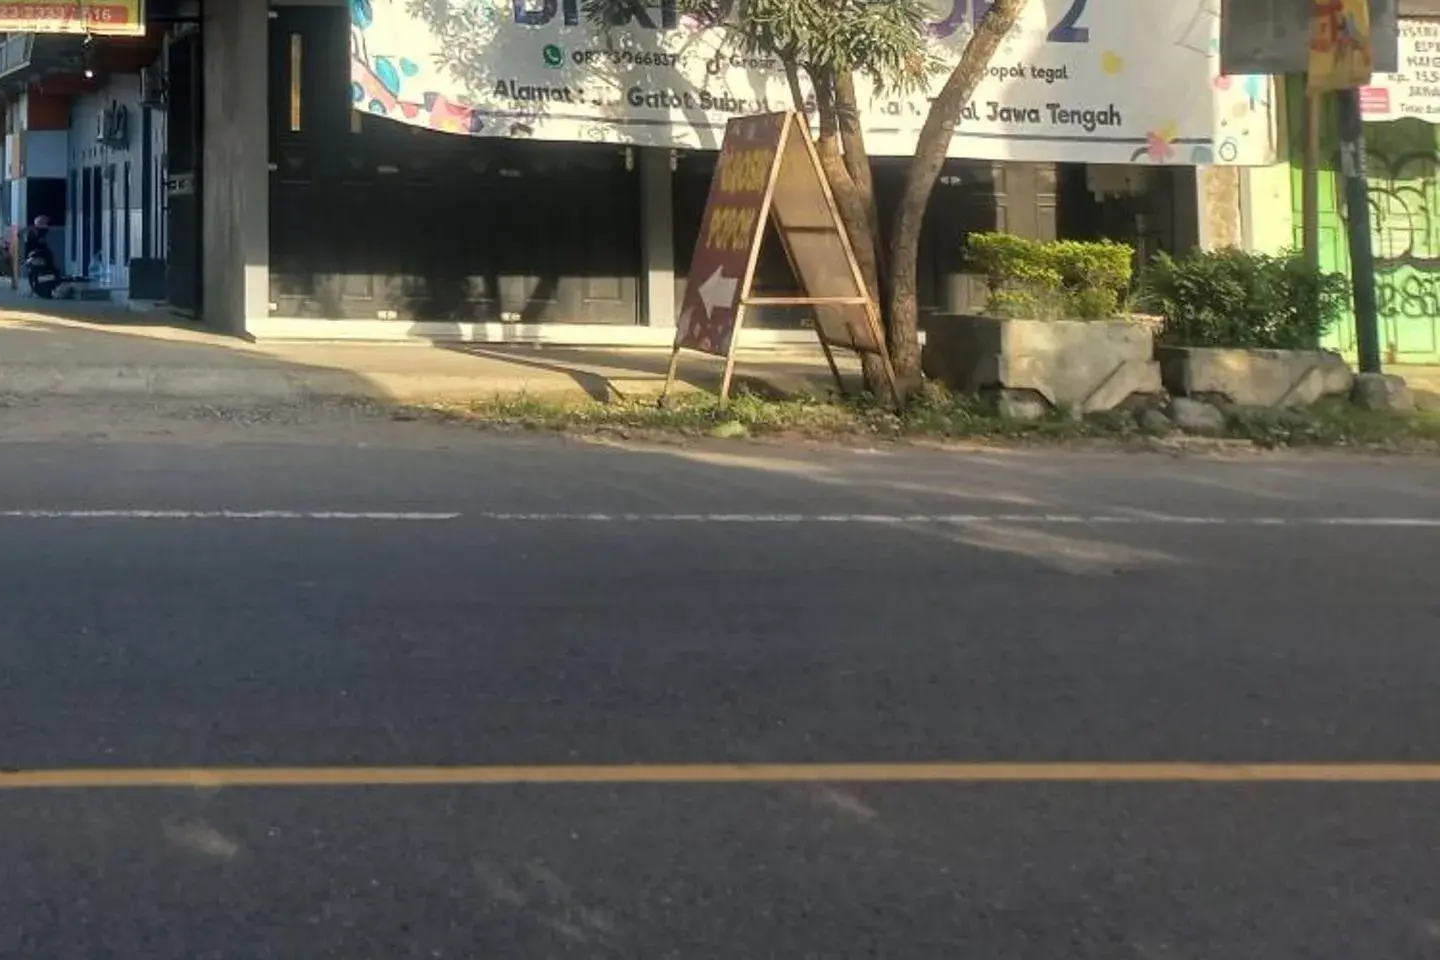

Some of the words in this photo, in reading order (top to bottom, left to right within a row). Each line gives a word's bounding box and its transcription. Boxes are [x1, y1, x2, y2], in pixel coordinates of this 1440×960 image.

[1030, 64, 1069, 84] tegal
[493, 78, 574, 104] Alamat
[627, 86, 695, 109] Gatot
[986, 101, 1041, 123] Jawa
[1046, 102, 1123, 132] Tengah
